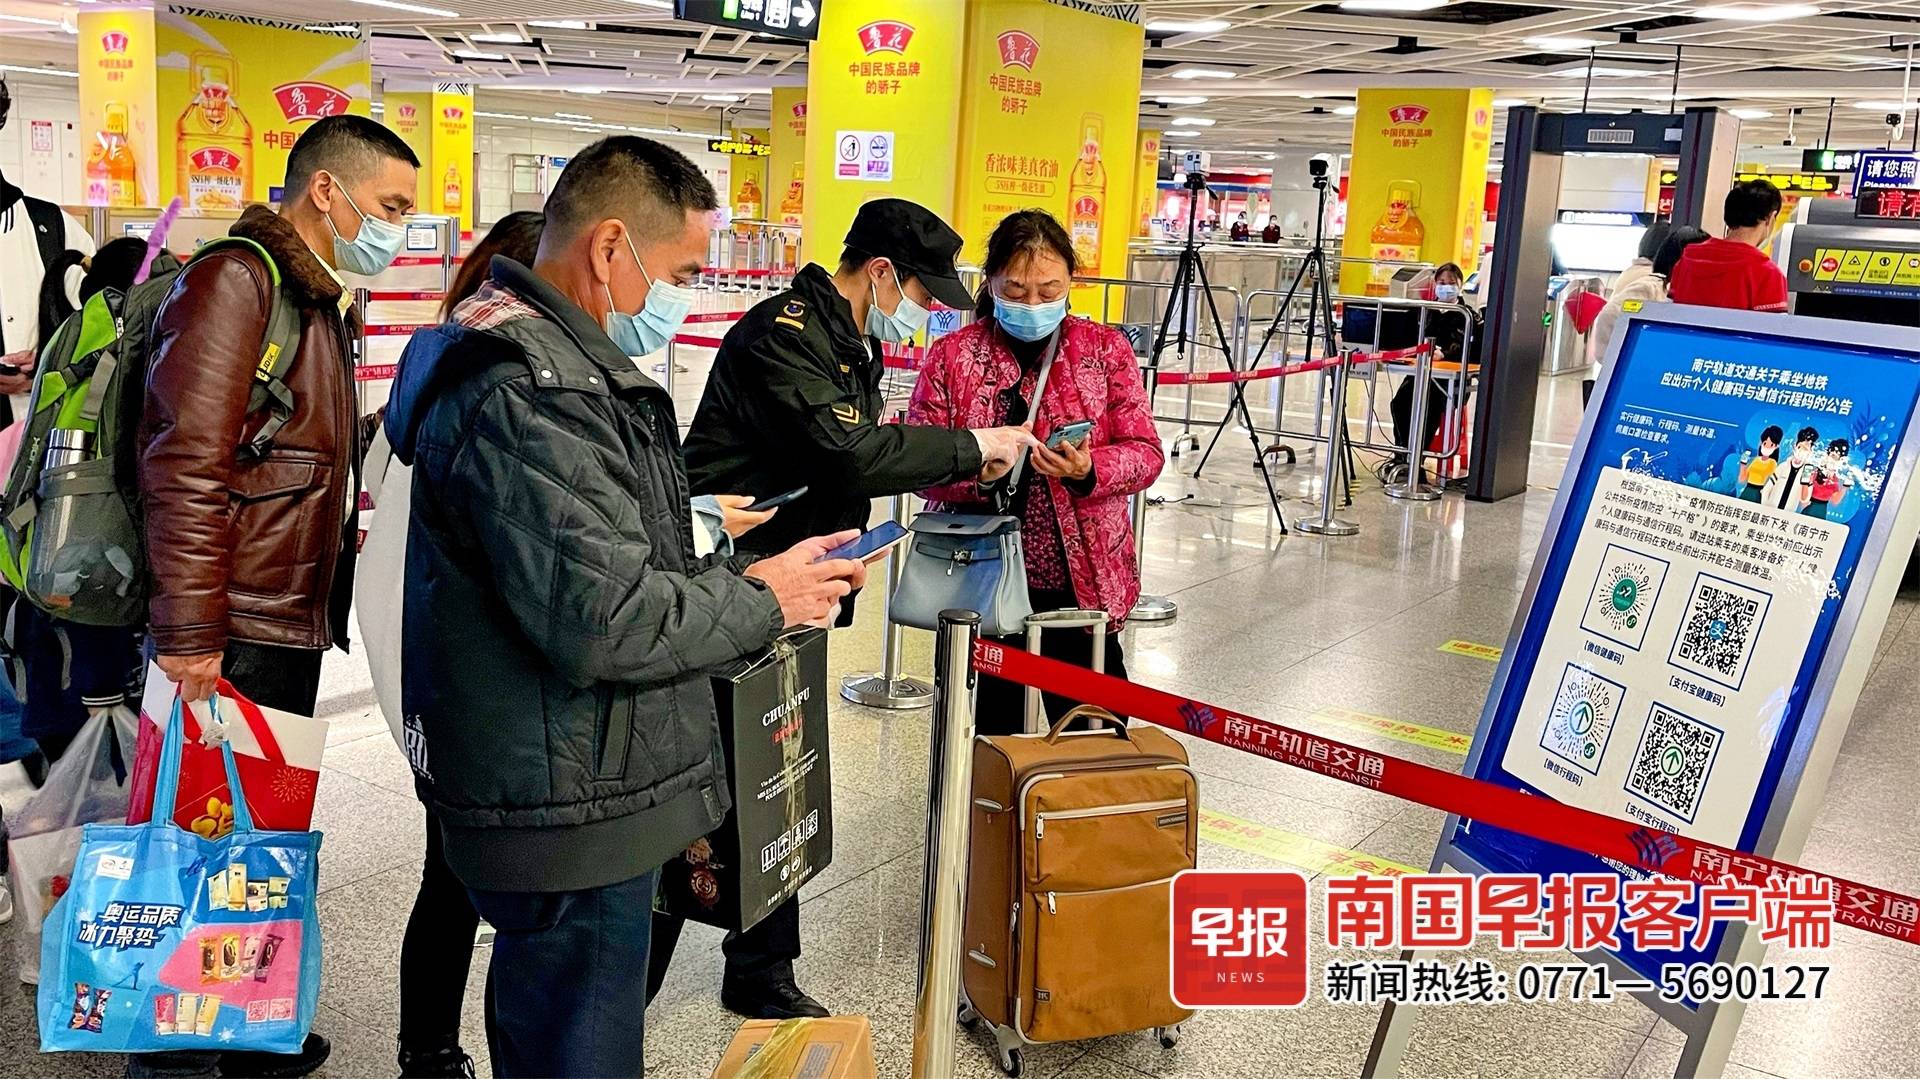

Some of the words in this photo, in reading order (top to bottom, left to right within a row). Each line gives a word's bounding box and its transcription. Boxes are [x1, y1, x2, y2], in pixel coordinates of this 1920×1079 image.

[849, 61, 921, 78] 中国民族品牌
[865, 79, 902, 95] 的骄子
[989, 73, 1042, 97] 中国民族品牌
[1001, 95, 1028, 115] 的骄子
[263, 129, 301, 150] 中国
[985, 153, 1059, 178] 香浓味美真省油
[1691, 357, 1828, 391] 南宁轨道交通关于乘坐地铁
[1660, 371, 1854, 416] 应出示个人健康码与通信行程码的公告
[762, 686, 810, 727] CHUANFU
[1223, 714, 1386, 779] 南宁轨道交通
[1223, 736, 1284, 761] NANNING
[1289, 753, 1318, 771] RAIL
[1322, 763, 1383, 789] TRANSIT
[99, 902, 182, 929] 奥运品质
[79, 922, 159, 949] 冰力聚势
